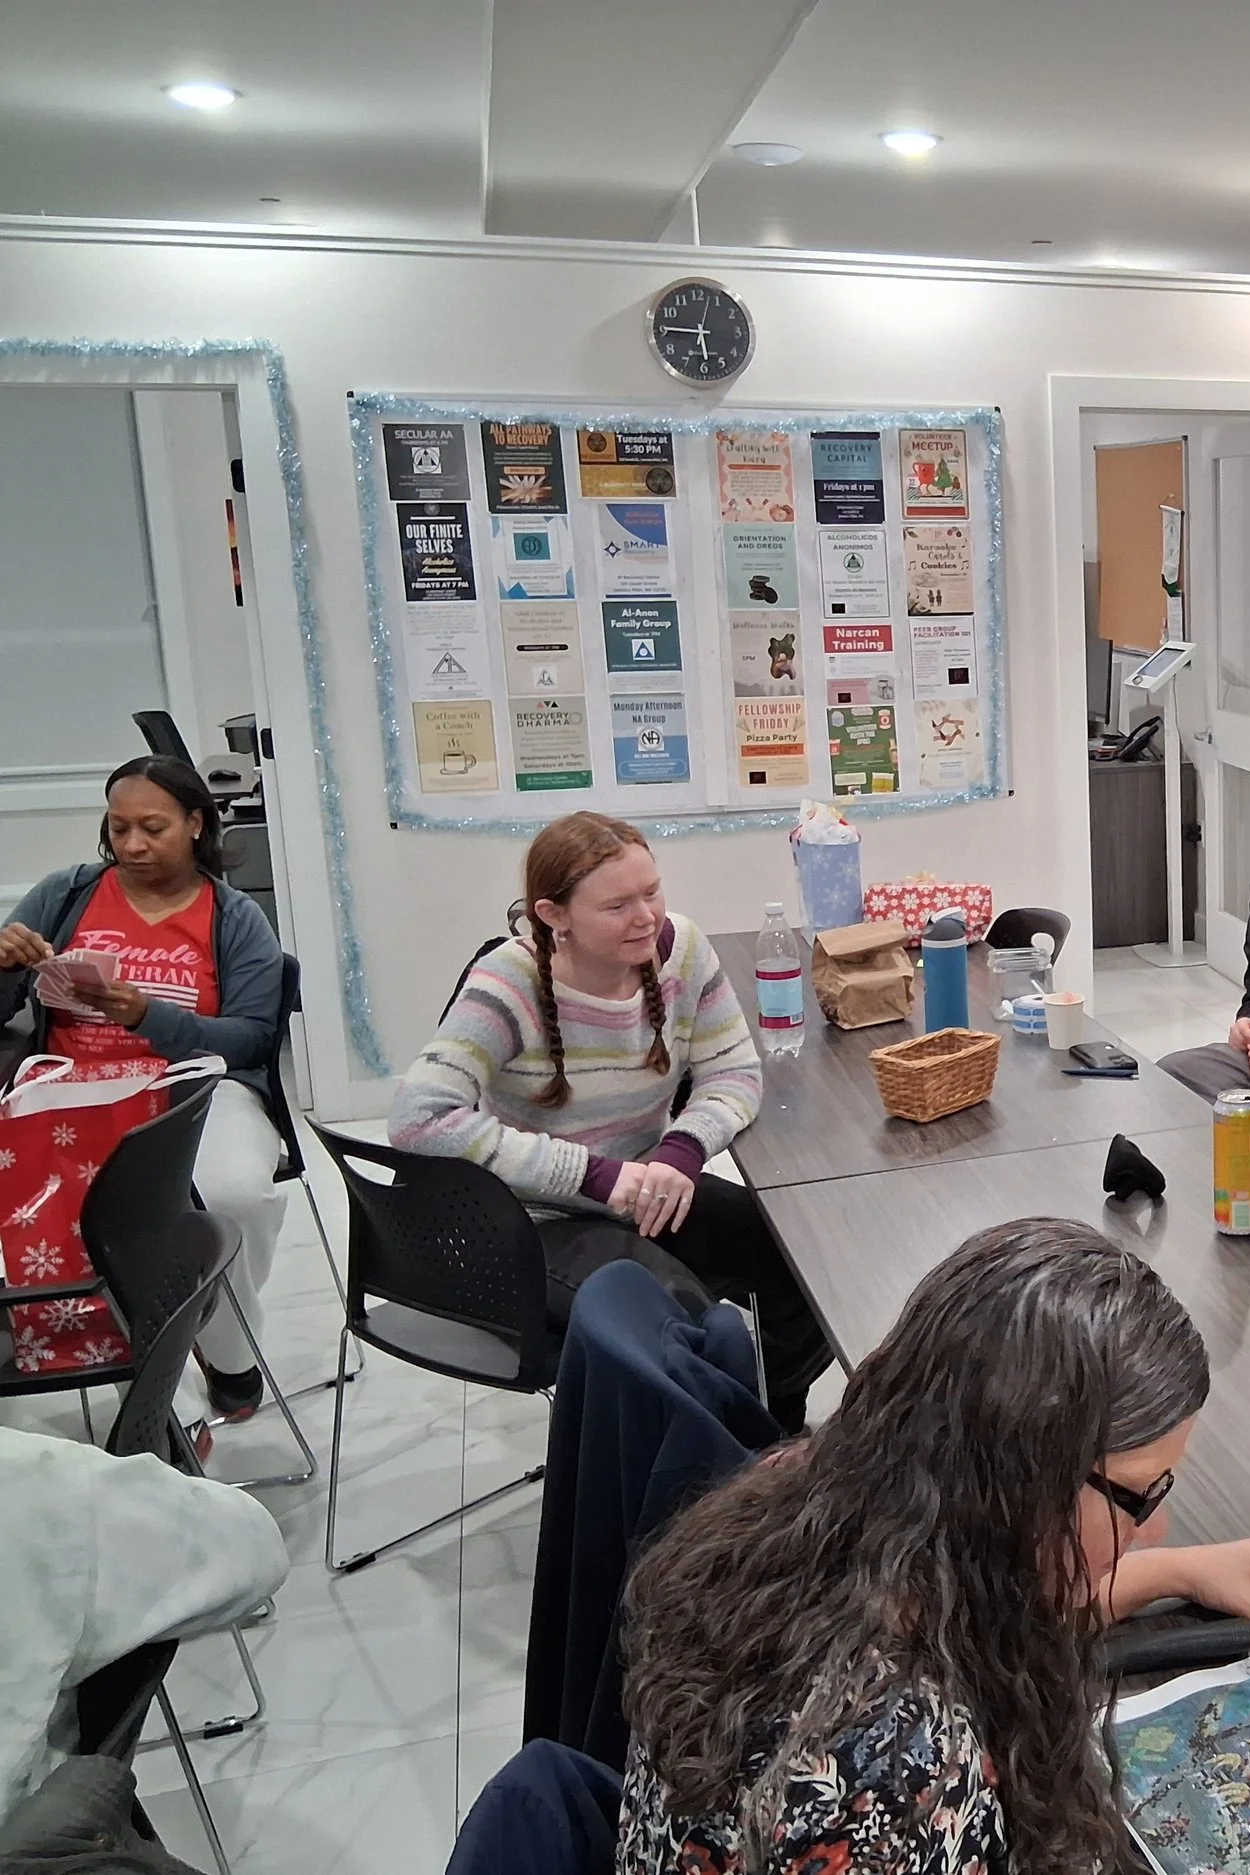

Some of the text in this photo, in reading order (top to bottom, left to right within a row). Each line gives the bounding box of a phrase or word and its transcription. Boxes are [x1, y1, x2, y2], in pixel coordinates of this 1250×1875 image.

[691, 290, 705, 300] 12
[675, 295, 687, 306] 11
[714, 296, 720, 306] 1
[663, 307, 677, 318] 10
[728, 308, 735, 319] 2
[660, 325, 668, 336] 9
[734, 326, 742, 338] 3
[666, 344, 674, 354] 8
[730, 347, 738, 357] 4
[682, 357, 689, 367] 7
[718, 357, 726, 368] 5
[700, 362, 708, 373] 6
[506, 424, 552, 434] PATHWAYS
[395, 430, 453, 439] SECULAR AA
[494, 434, 548, 445] TO RECOVERY
[616, 435, 656, 445] Tuesdays
[646, 446, 661, 454] PM
[821, 444, 872, 452] RECOVERY
[912, 442, 953, 450] MEETUP
[828, 454, 866, 462] CAPITAL
[824, 483, 849, 492] Fridays
[406, 524, 463, 538] OUR FINITE
[416, 539, 454, 553] SELVES
[622, 609, 658, 617] Al-Anon
[611, 619, 671, 629] Family Group
[836, 628, 879, 637] Narcan
[832, 640, 884, 650] Training
[614, 702, 682, 712] Monday Afternoon
[739, 703, 801, 715] FELLOWSHIP
[426, 712, 457, 720] Coffee
[517, 712, 568, 720] RECOVERY
[644, 715, 666, 723] Group
[754, 718, 788, 729] FRIDAY
[772, 734, 797, 742] Party
[78, 930, 203, 964] Female
[118, 962, 198, 986] TERAN
